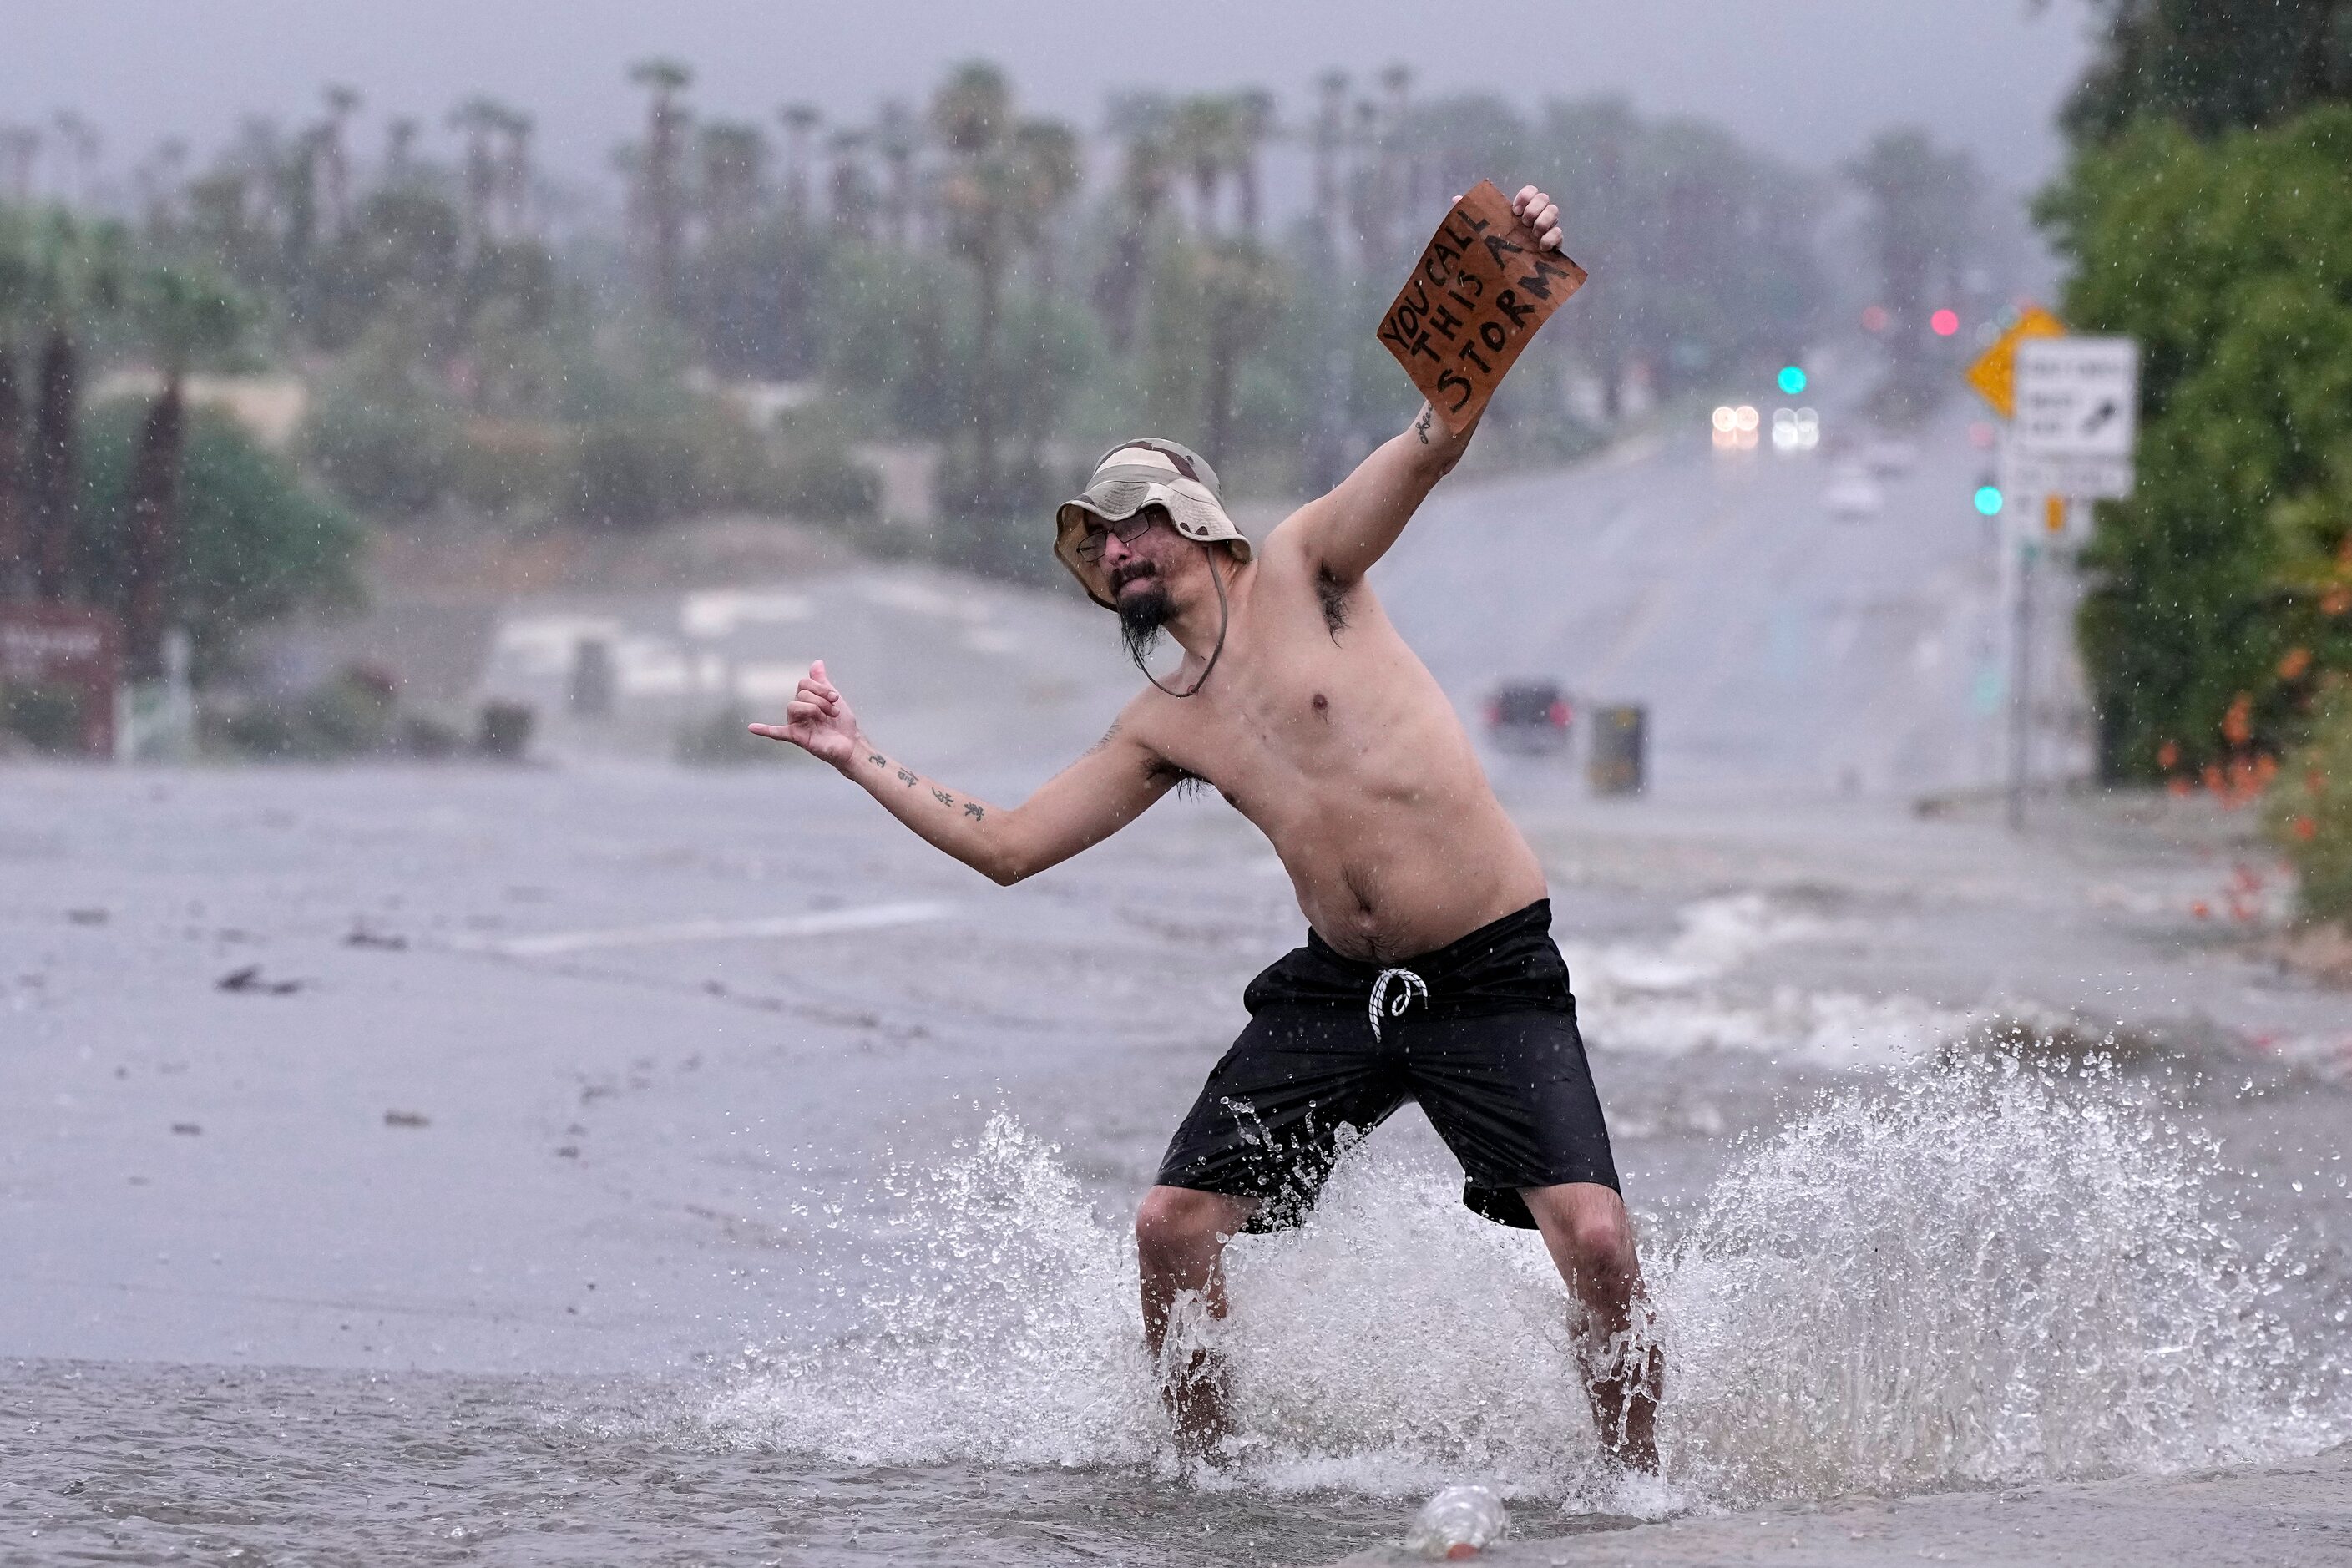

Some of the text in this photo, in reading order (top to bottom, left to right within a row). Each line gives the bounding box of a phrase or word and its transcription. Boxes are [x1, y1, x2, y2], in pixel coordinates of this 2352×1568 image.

[1383, 210, 1490, 350] YOU CALL
[1410, 235, 1524, 362] THIS A
[1437, 260, 1571, 415] STORM
